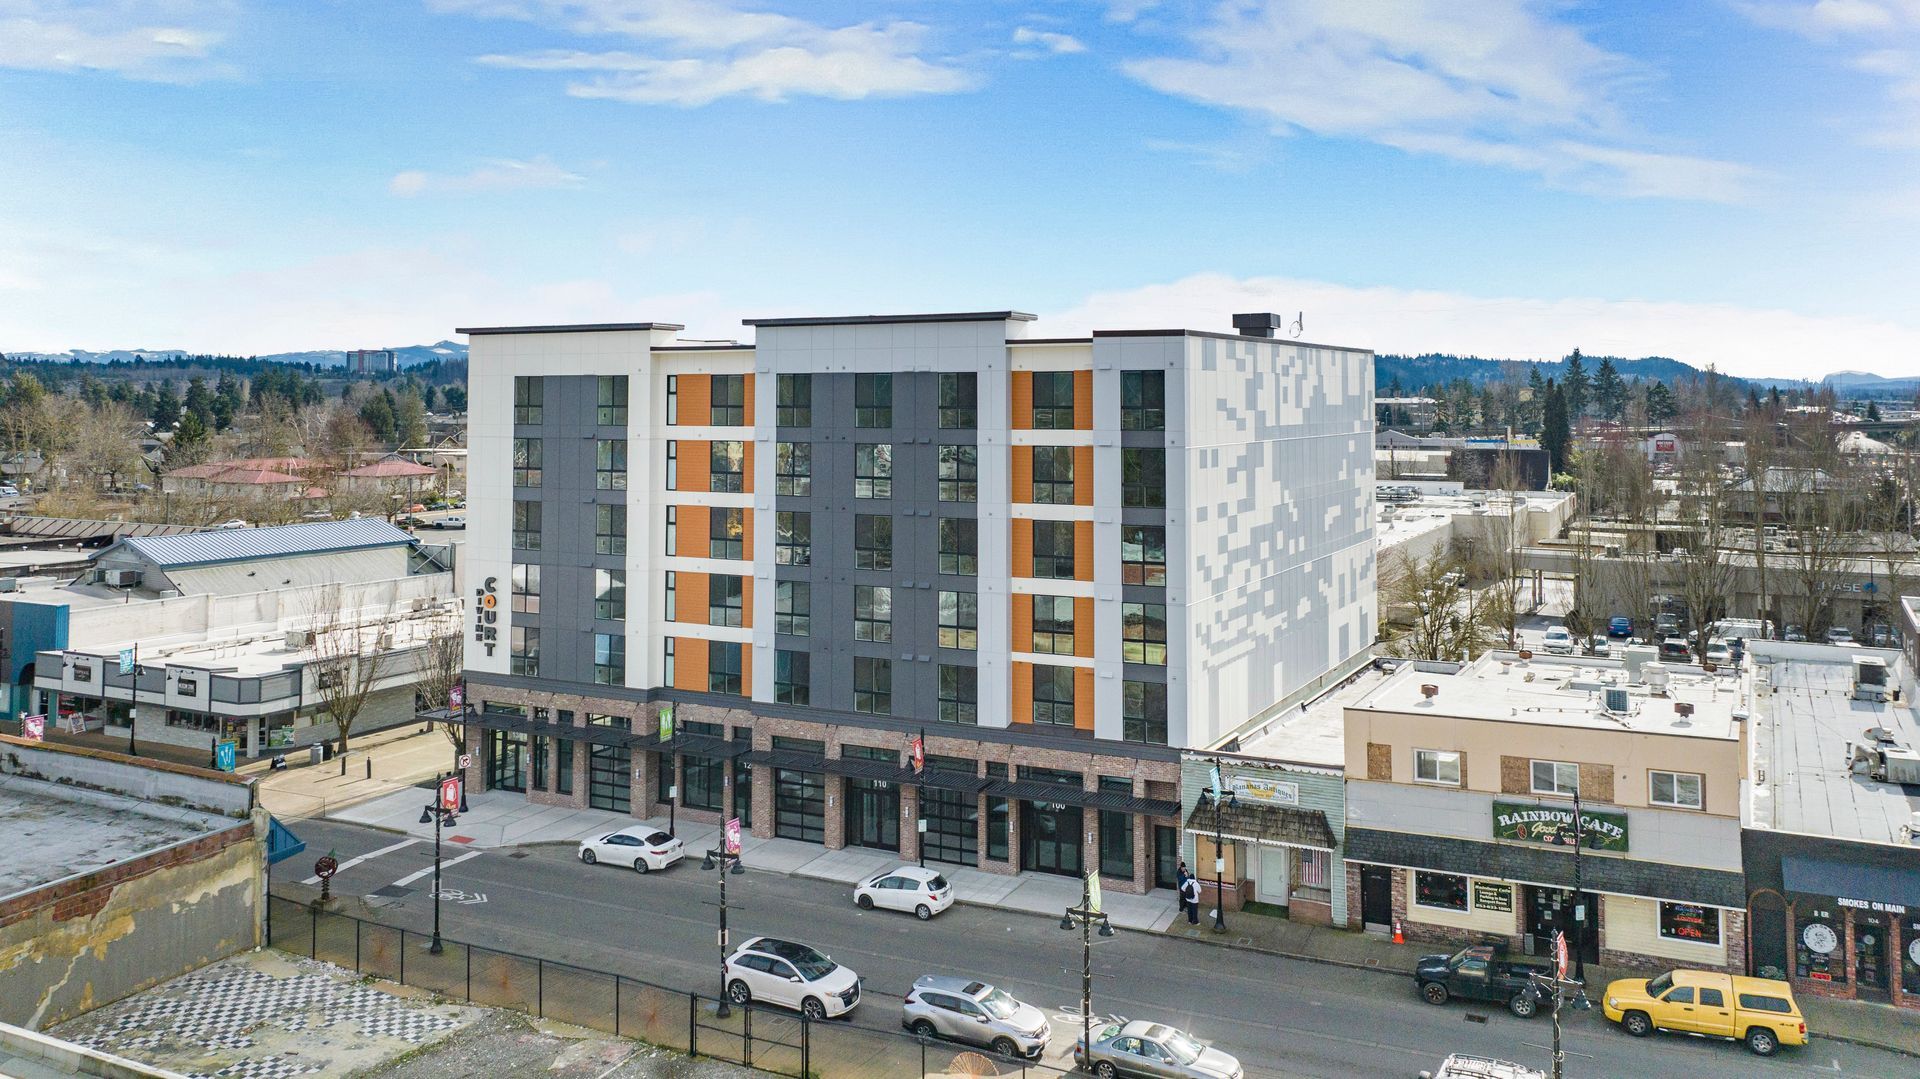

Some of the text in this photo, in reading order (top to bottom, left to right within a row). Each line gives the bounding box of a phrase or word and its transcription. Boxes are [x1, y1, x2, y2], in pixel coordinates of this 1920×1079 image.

[475, 588, 484, 642] DIVINE
[484, 576, 497, 657] COURT
[873, 780, 887, 788] 110
[1498, 810, 1574, 827] RAINBOW
[1580, 816, 1624, 839] CAFE
[1531, 822, 1560, 838] Good
[1837, 897, 1905, 914] SMOKES ON MAIN
[1677, 927, 1702, 938] OPEN
